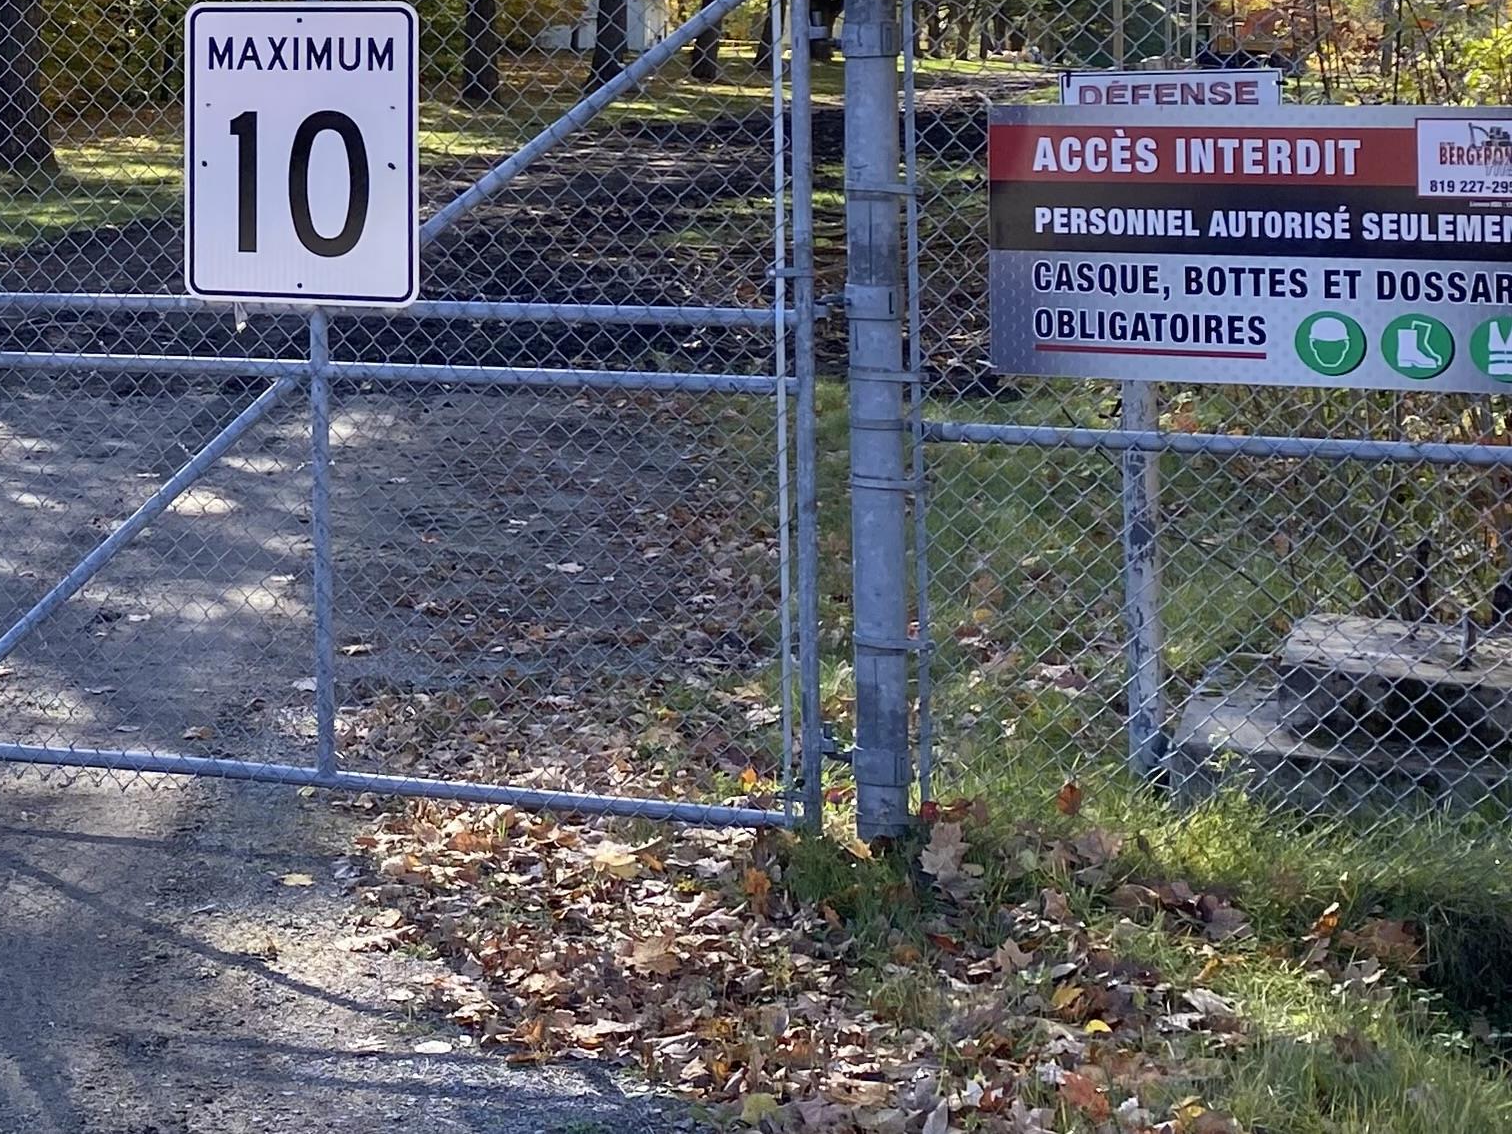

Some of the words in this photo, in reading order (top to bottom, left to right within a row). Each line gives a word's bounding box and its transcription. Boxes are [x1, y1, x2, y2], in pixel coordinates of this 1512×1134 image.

[208, 36, 394, 72] MAXIMUM
[1078, 80, 1260, 105] DÉFENSE
[1033, 129, 1159, 174] ACCÈS
[1175, 137, 1361, 176] INTERDIT
[229, 109, 370, 258] 10
[1430, 179, 1456, 194] 819
[1034, 206, 1200, 237] PERSONNEL
[1208, 205, 1351, 240] AUTORISÉ
[1033, 261, 1171, 301] CASQUE,
[1184, 265, 1308, 298] BOTTES
[1324, 269, 1361, 300] ET
[1034, 309, 1268, 346] OBLIGATOIRES
